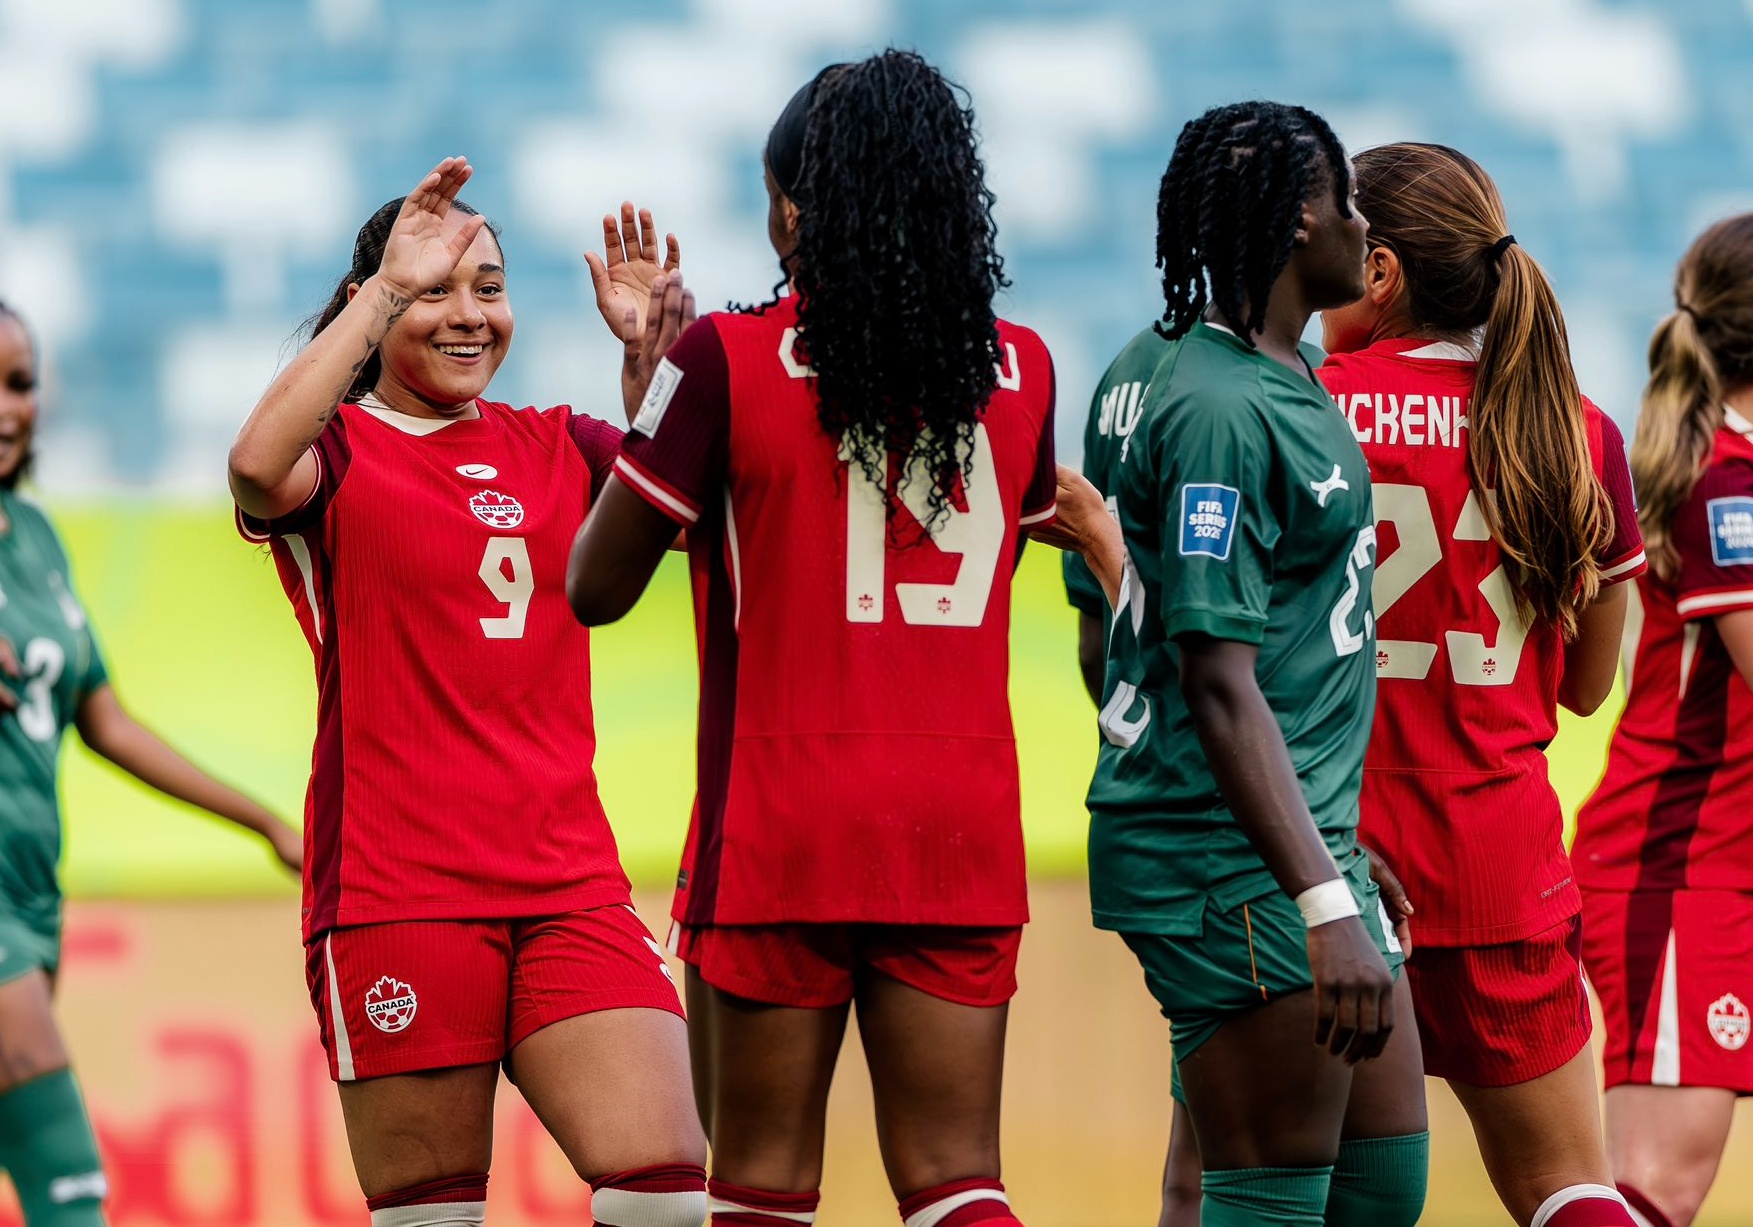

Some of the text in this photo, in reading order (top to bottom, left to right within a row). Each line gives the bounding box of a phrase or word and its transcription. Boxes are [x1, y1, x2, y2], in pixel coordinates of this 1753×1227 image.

[838, 421, 1005, 627] 19
[1197, 501, 1223, 514] FIFA
[478, 536, 535, 639] 9
[1329, 525, 1377, 657] 2
[1371, 483, 1537, 685] 23
[17, 637, 65, 742] 3
[368, 998, 414, 1014] CANADA
